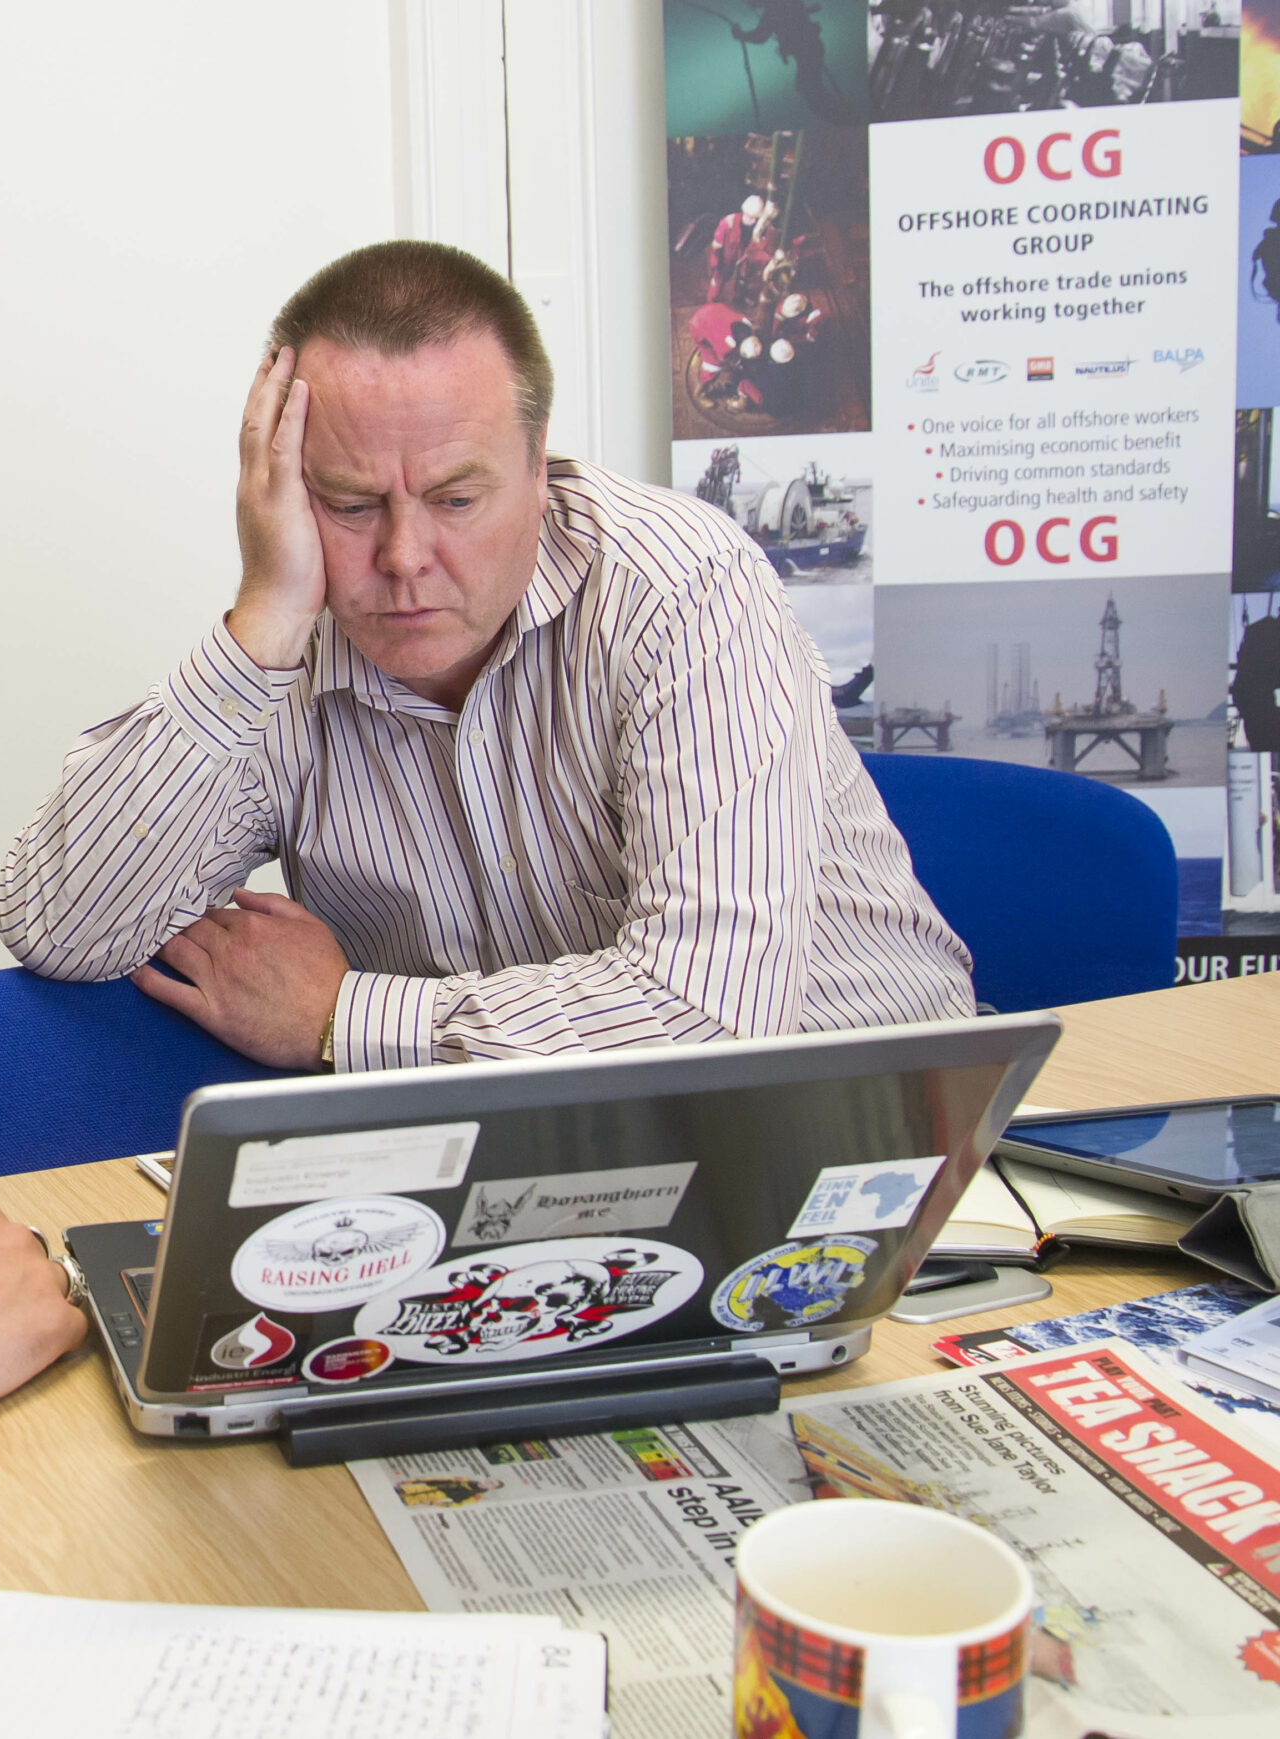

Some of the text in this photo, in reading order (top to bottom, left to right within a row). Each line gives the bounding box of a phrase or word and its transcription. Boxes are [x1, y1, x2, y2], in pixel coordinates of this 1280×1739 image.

[983, 128, 1122, 185] OCG
[898, 195, 1209, 232] OFFSHORE COORDINATING
[1012, 233, 1095, 256] GROUP
[919, 267, 1188, 298] The offshore trade unions
[961, 298, 1146, 323] working together
[1153, 348, 1205, 363] BALPA
[966, 367, 1001, 377] RMT
[922, 406, 1200, 435] One voice for all offshore workers
[940, 433, 1182, 459] Maximising economic benefit
[950, 459, 1170, 485] Driving common standards
[933, 483, 1189, 512] Safeguarding health and safety
[984, 515, 1119, 566] OCG
[816, 1179, 857, 1192] FINN
[806, 1191, 852, 1210] EN
[799, 1210, 837, 1223] FEIL
[260, 1250, 412, 1287] RAISING HELL
[1093, 1357, 1125, 1377] PLAY
[1142, 1398, 1181, 1419] PART
[933, 1390, 1058, 1495] from Sue Jane Taylor
[958, 1384, 1066, 1476] Stunning pictures
[1028, 1361, 1280, 1545] TEA SHACK
[667, 1486, 719, 1528] step
